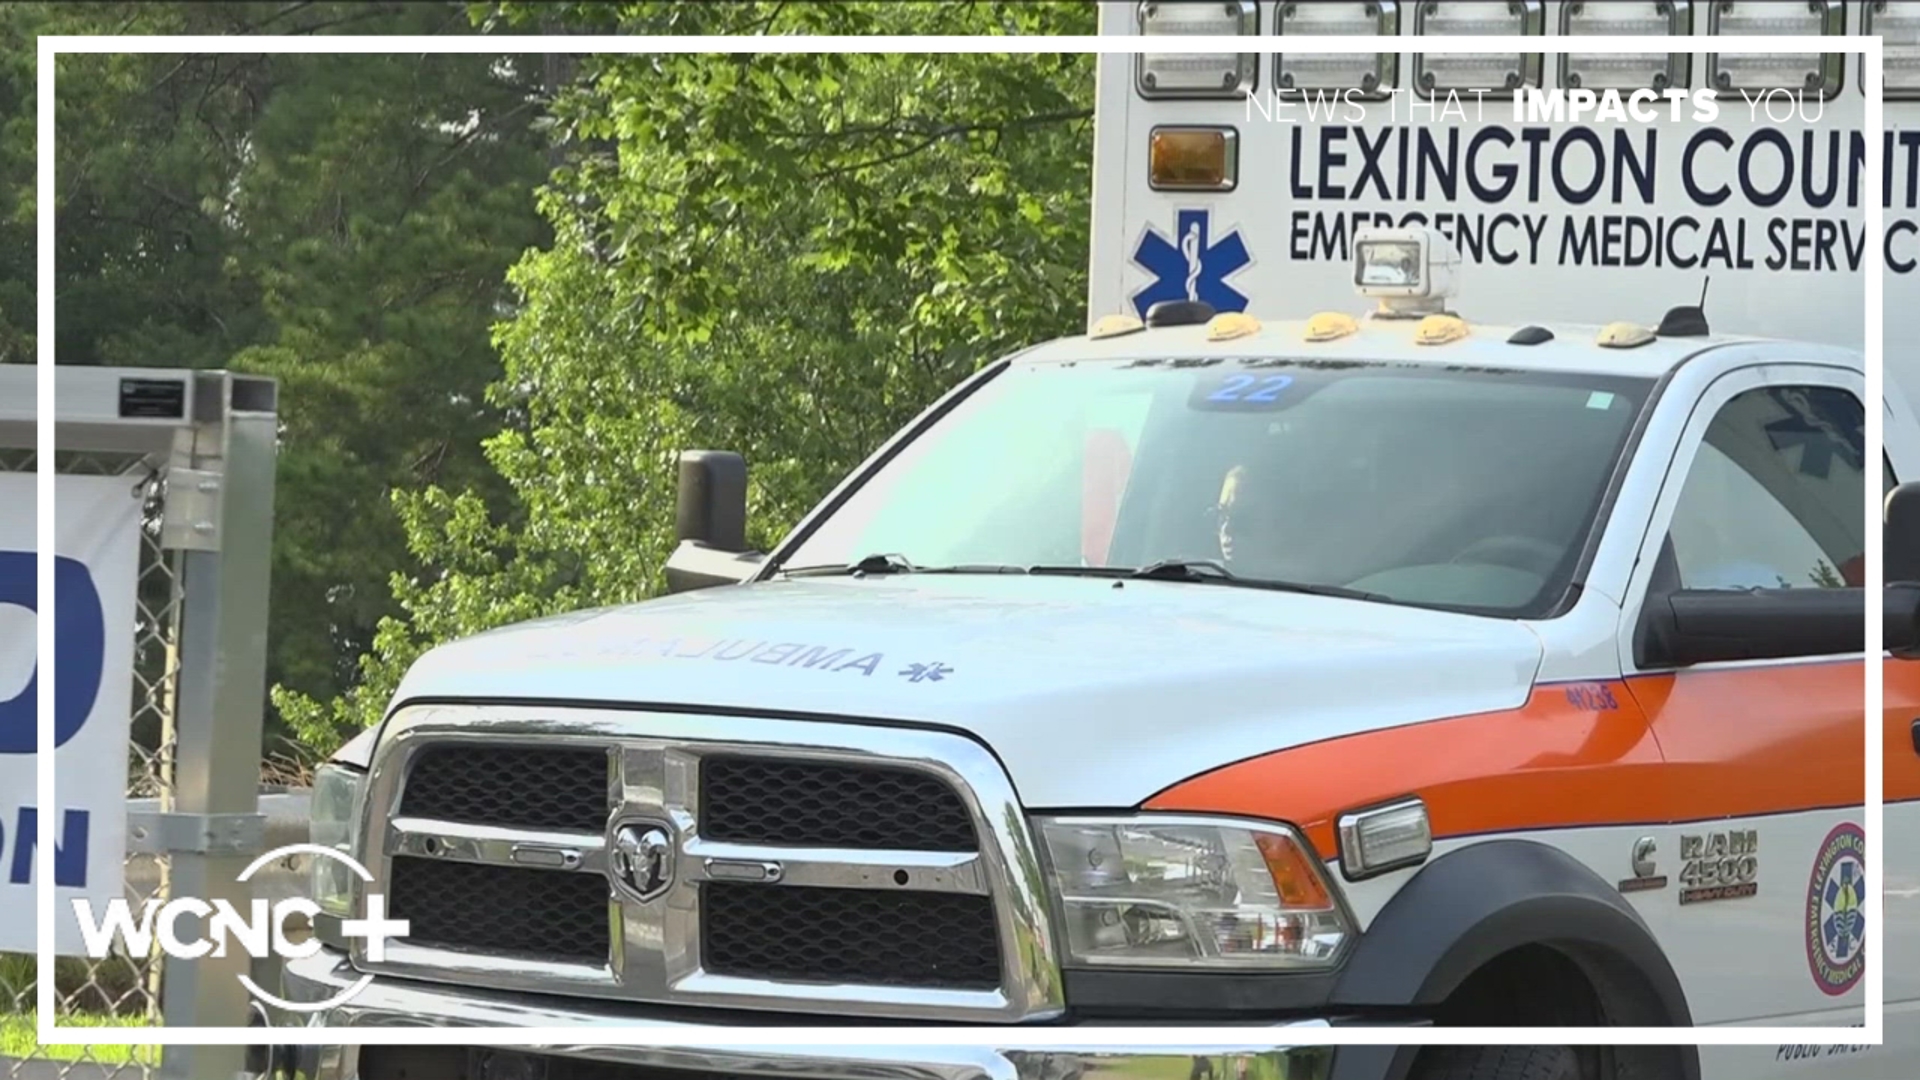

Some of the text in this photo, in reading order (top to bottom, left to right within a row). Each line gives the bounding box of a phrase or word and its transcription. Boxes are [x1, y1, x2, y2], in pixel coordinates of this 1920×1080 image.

[1290, 126, 1658, 205] LEXINGTON
[1558, 215, 1754, 269] MEDICAL
[1765, 217, 1919, 273] SERVC
[1206, 374, 1293, 401] 22
[1681, 829, 1757, 860] RAM
[1679, 856, 1758, 888] 4500
